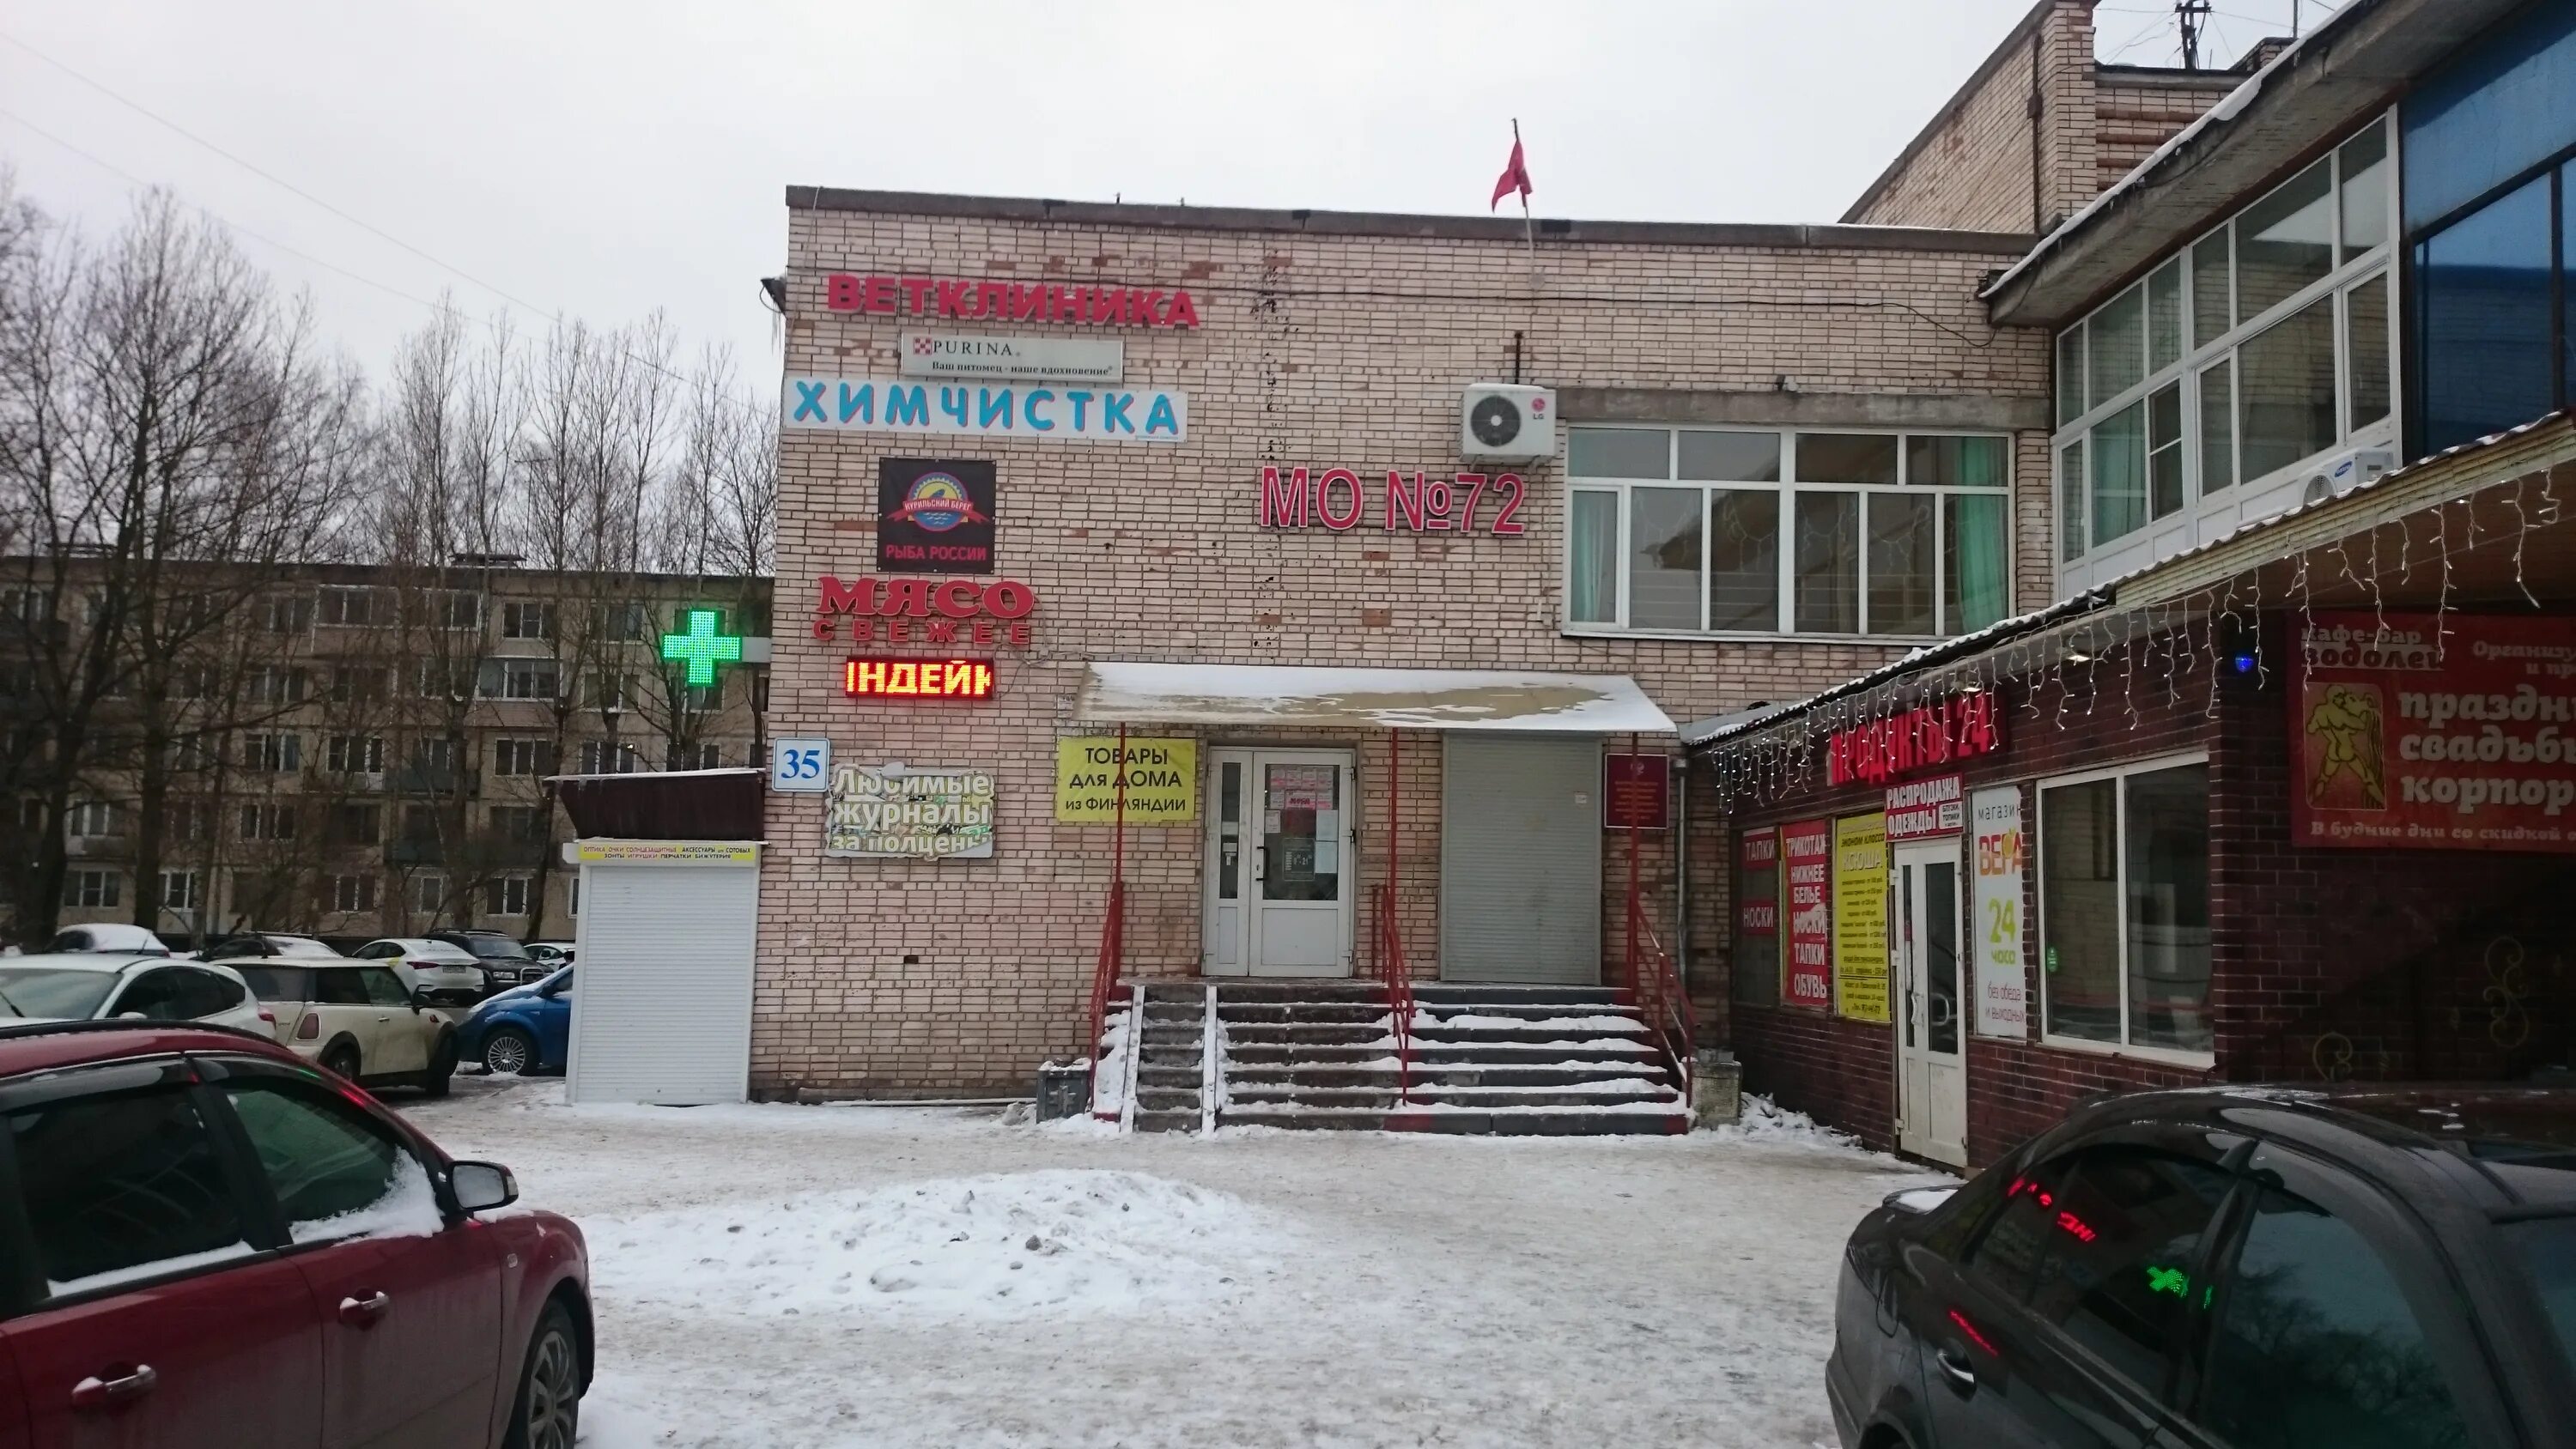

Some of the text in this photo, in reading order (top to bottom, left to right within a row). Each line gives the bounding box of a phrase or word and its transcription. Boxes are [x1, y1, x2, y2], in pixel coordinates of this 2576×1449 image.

[828, 275, 1200, 329] ВЕТКЛИНИКА
[933, 341, 1012, 356] PURINA
[933, 361, 954, 371] Ваш
[957, 364, 1003, 373] питомец
[1011, 366, 1038, 374] наше
[1041, 367, 1109, 376] вдохновение
[793, 379, 1179, 435] ХИМЧИСТКА
[904, 498, 972, 511] КУРИЛЬСКИЙ БЕРЕГ
[1261, 466, 1525, 534] МО №72
[885, 544, 987, 561] РЫБА РОССИИ
[817, 576, 1036, 618] МЯСО
[812, 620, 1032, 645] СВЕЖЕЕ
[2545, 663, 2576, 679] пр
[2398, 684, 2576, 729] праздн
[1832, 688, 1990, 785] ПРОДУКТЫ 24
[781, 749, 820, 779] 35
[1085, 747, 1168, 765] ТОВАРЫ
[1069, 770, 1182, 789] для ДОМА
[1886, 776, 1960, 810] РАСПРОДАЖА
[1066, 797, 1186, 812] из ФИНЛЯНДИИ
[834, 803, 990, 832] журналы
[1887, 809, 1936, 838] ОДЕЖДЫ
[2312, 822, 2324, 835] В
[2330, 821, 2402, 839] будние
[2408, 822, 2445, 838] дни
[2451, 826, 2473, 839] со
[2479, 825, 2561, 840] скидкой
[832, 836, 859, 850] за
[1746, 839, 1775, 860] ТАПКИ
[1790, 864, 1825, 882] НИЖНЕЕ
[1793, 886, 1821, 904] БЕЛЬЕ
[1743, 906, 1774, 928] НОСКИ
[1793, 912, 1826, 935] НОСКИ
[1989, 899, 2016, 943] 24
[1794, 943, 1825, 966] ТАПКИ
[1991, 949, 2016, 965] часа
[1794, 973, 1827, 999] ОБУВЬ
[1987, 980, 2021, 1002] без обеда
